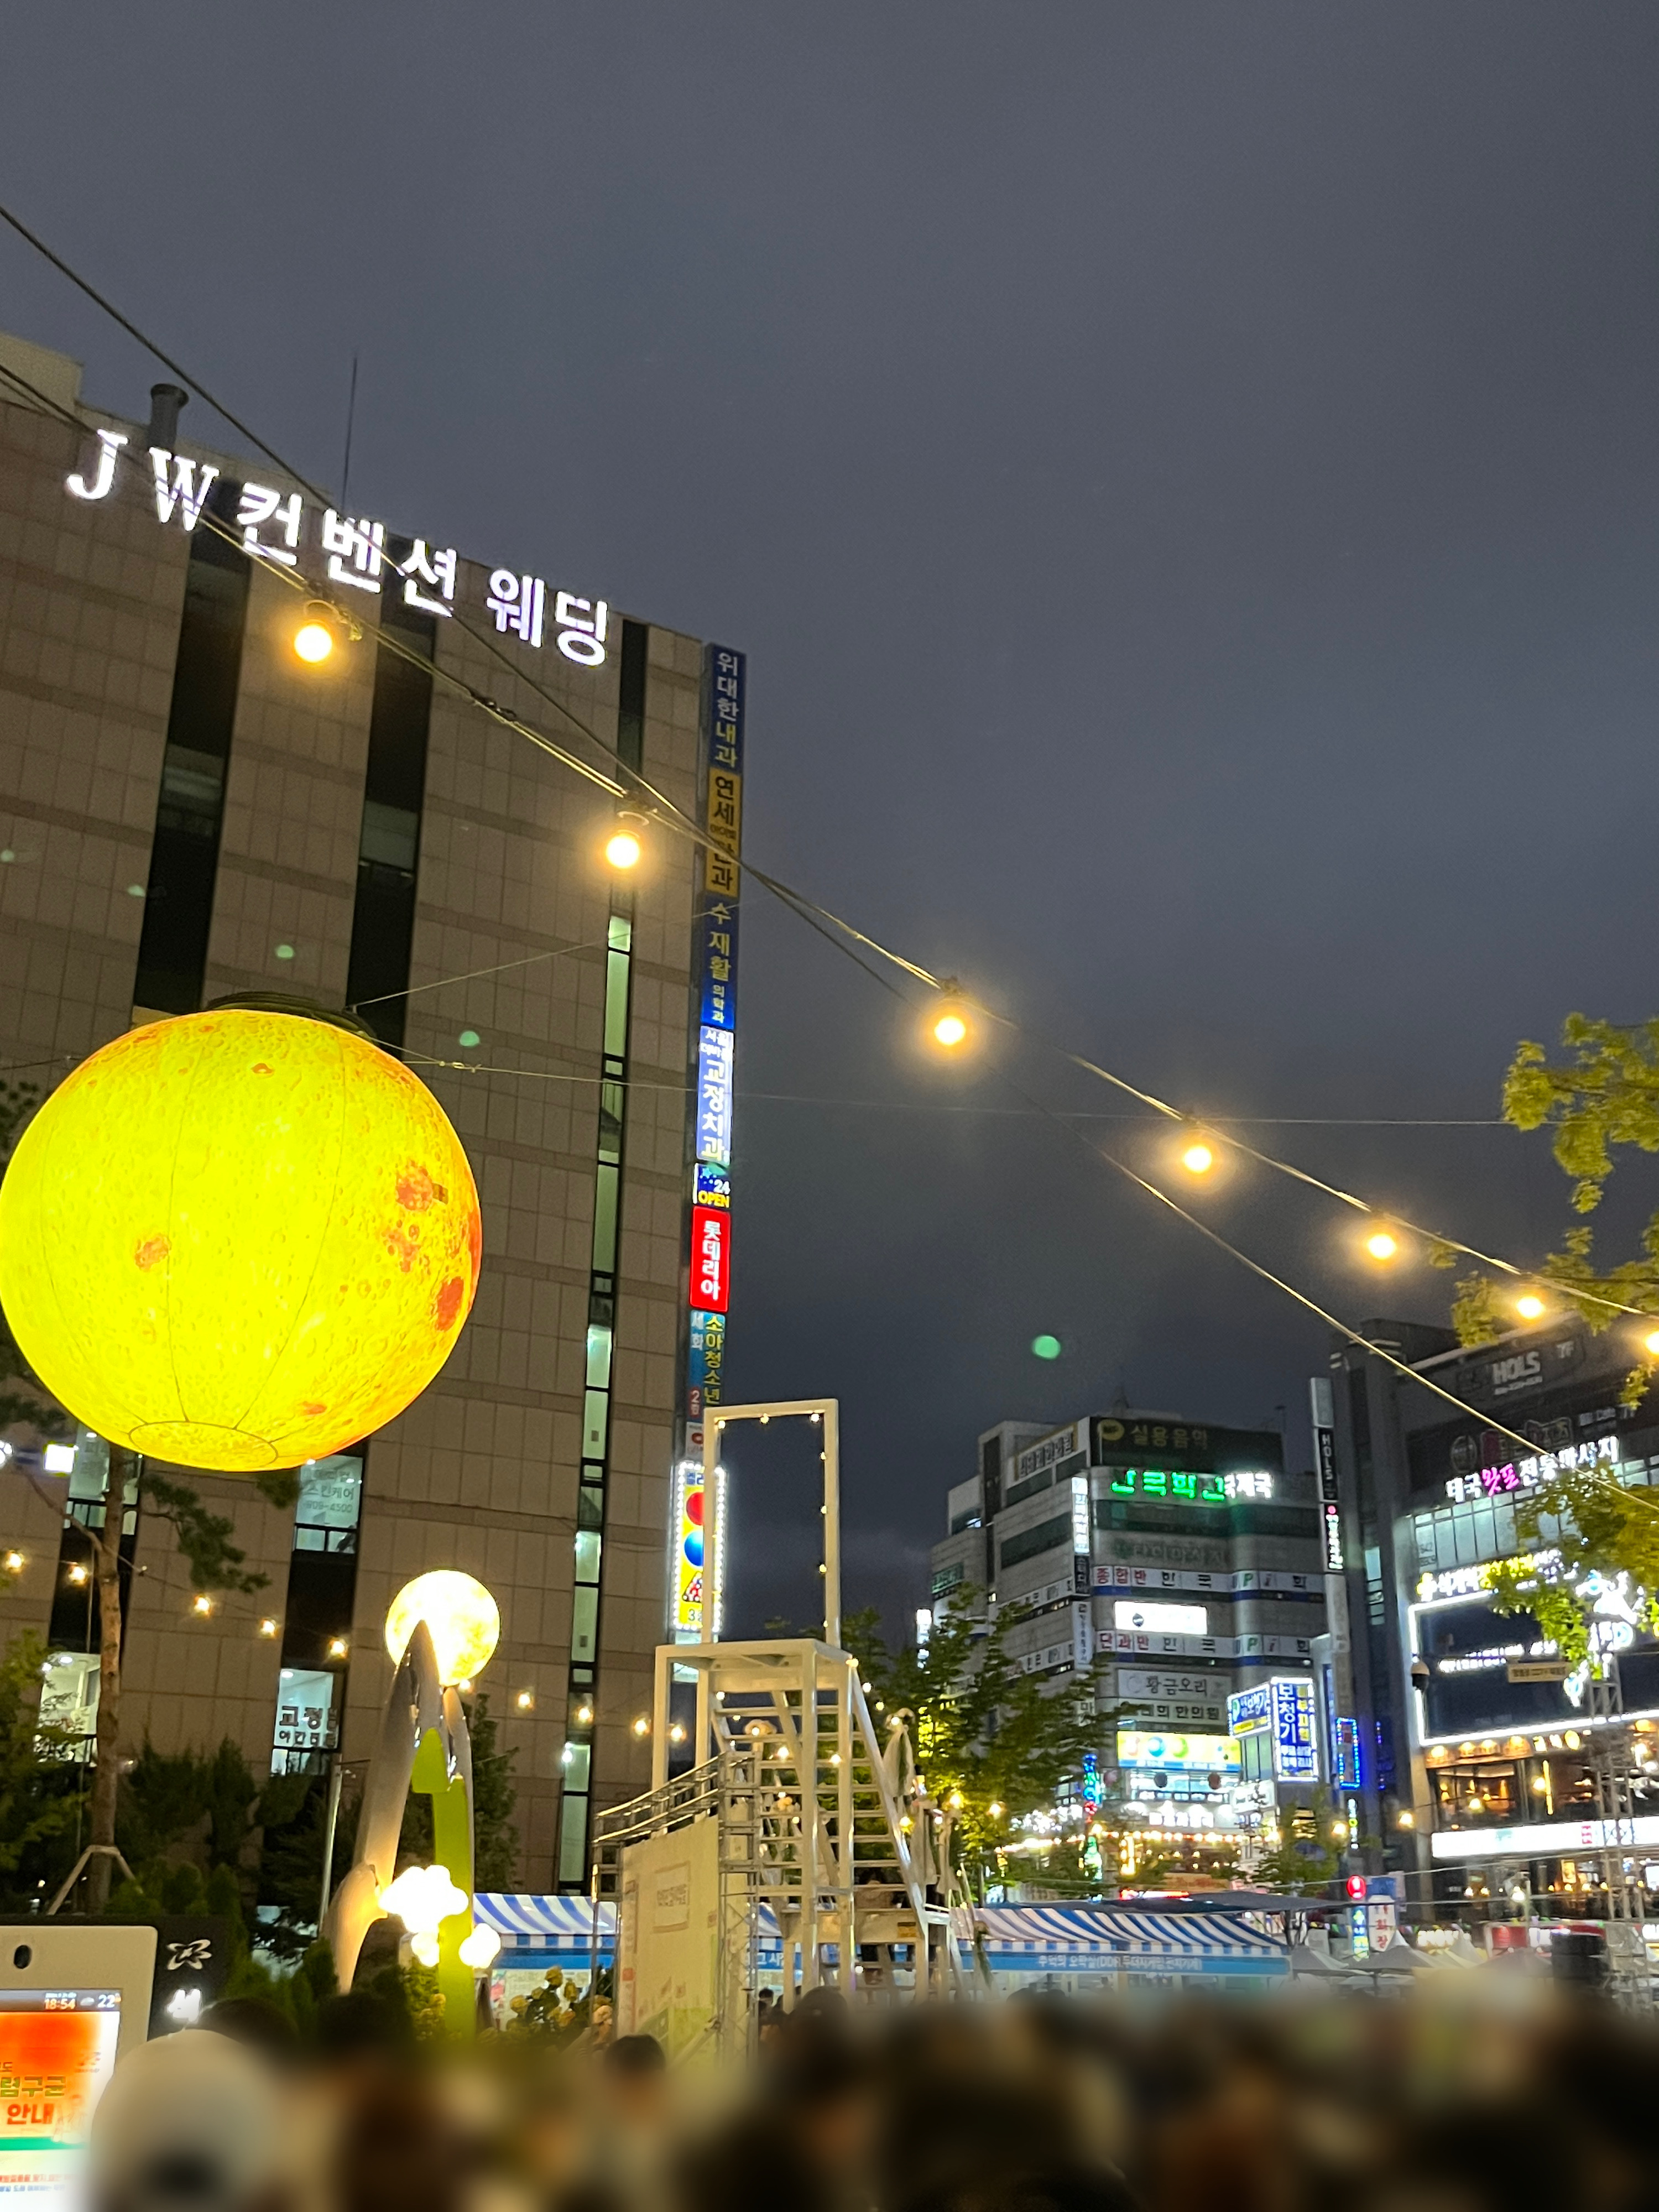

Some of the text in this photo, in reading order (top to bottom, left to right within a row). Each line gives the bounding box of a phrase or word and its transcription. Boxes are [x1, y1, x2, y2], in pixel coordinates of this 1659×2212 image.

[485, 567, 609, 666] 웨딩
[713, 1178, 731, 1195] 24
[698, 1190, 730, 1208] OPEN
[700, 1220, 722, 1301] 롯데리아
[1145, 1675, 1208, 1697] 황금오리
[1278, 1683, 1296, 1744] 보청기
[45, 1998, 76, 2010] 18:54
[6, 2103, 55, 2125] 안내
